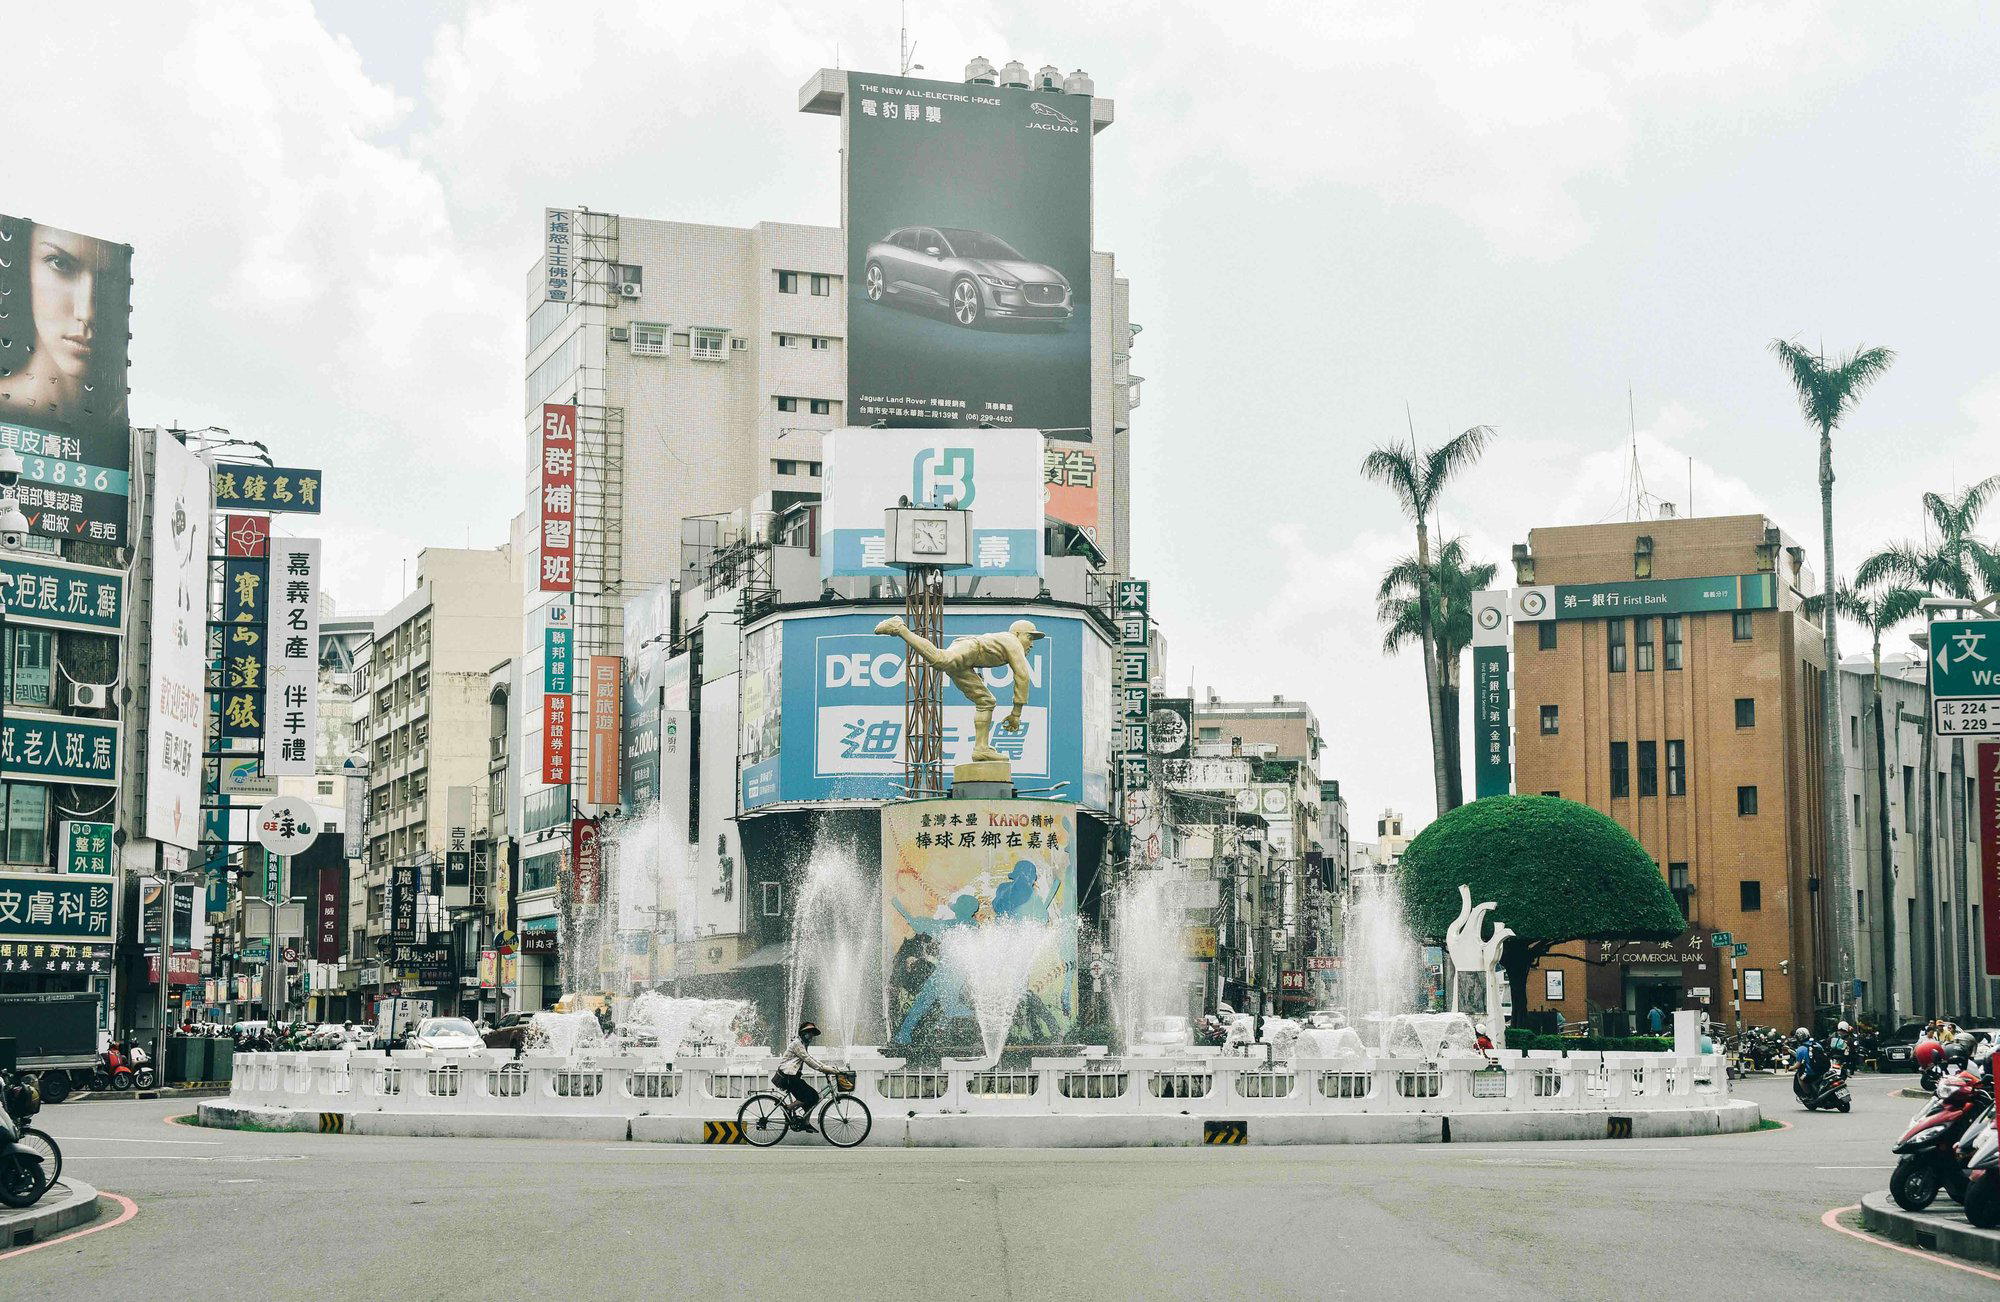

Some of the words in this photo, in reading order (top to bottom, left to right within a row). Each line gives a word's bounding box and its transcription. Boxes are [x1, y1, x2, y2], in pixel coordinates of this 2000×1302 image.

[860, 84, 879, 93] THE
[881, 87, 903, 96] NEW
[905, 90, 969, 103] ALL-ELECTRIC
[861, 98, 941, 123] 電豹靜襲
[1025, 122, 1079, 133] JAGUAR
[859, 394, 884, 403] Jaguar
[886, 396, 904, 404] Land
[905, 397, 926, 405] Rover
[542, 412, 573, 584] 弘群補習班
[42, 512, 70, 534] 細紋
[89, 520, 117, 541] 痘疤
[285, 552, 311, 659] 嘉義名產
[1564, 593, 1620, 608] 第一銀行
[1623, 595, 1642, 605] First
[1644, 593, 1668, 604] Bank
[1952, 629, 1988, 663] 文
[551, 631, 565, 691] 聯邦銀行
[1942, 703, 1955, 716] 北
[1960, 703, 1987, 714] 224
[282, 684, 308, 762] 伴手禮
[1943, 719, 1956, 731] N.
[1961, 719, 1988, 730] 229
[263, 817, 311, 839] 旺萊山
[920, 813, 978, 827] 臺灣本壘
[75, 836, 106, 853] 整形
[452, 827, 466, 851] 吉米
[915, 831, 1060, 850] 棒球原鄉在嘉義
[75, 856, 105, 874] 外科
[451, 862, 464, 871] HD
[0, 889, 86, 925] 皮膚科
[88, 886, 108, 933] 診所
[1622, 953, 1679, 963] COMMERCIAL
[1681, 953, 1704, 963] BANK
